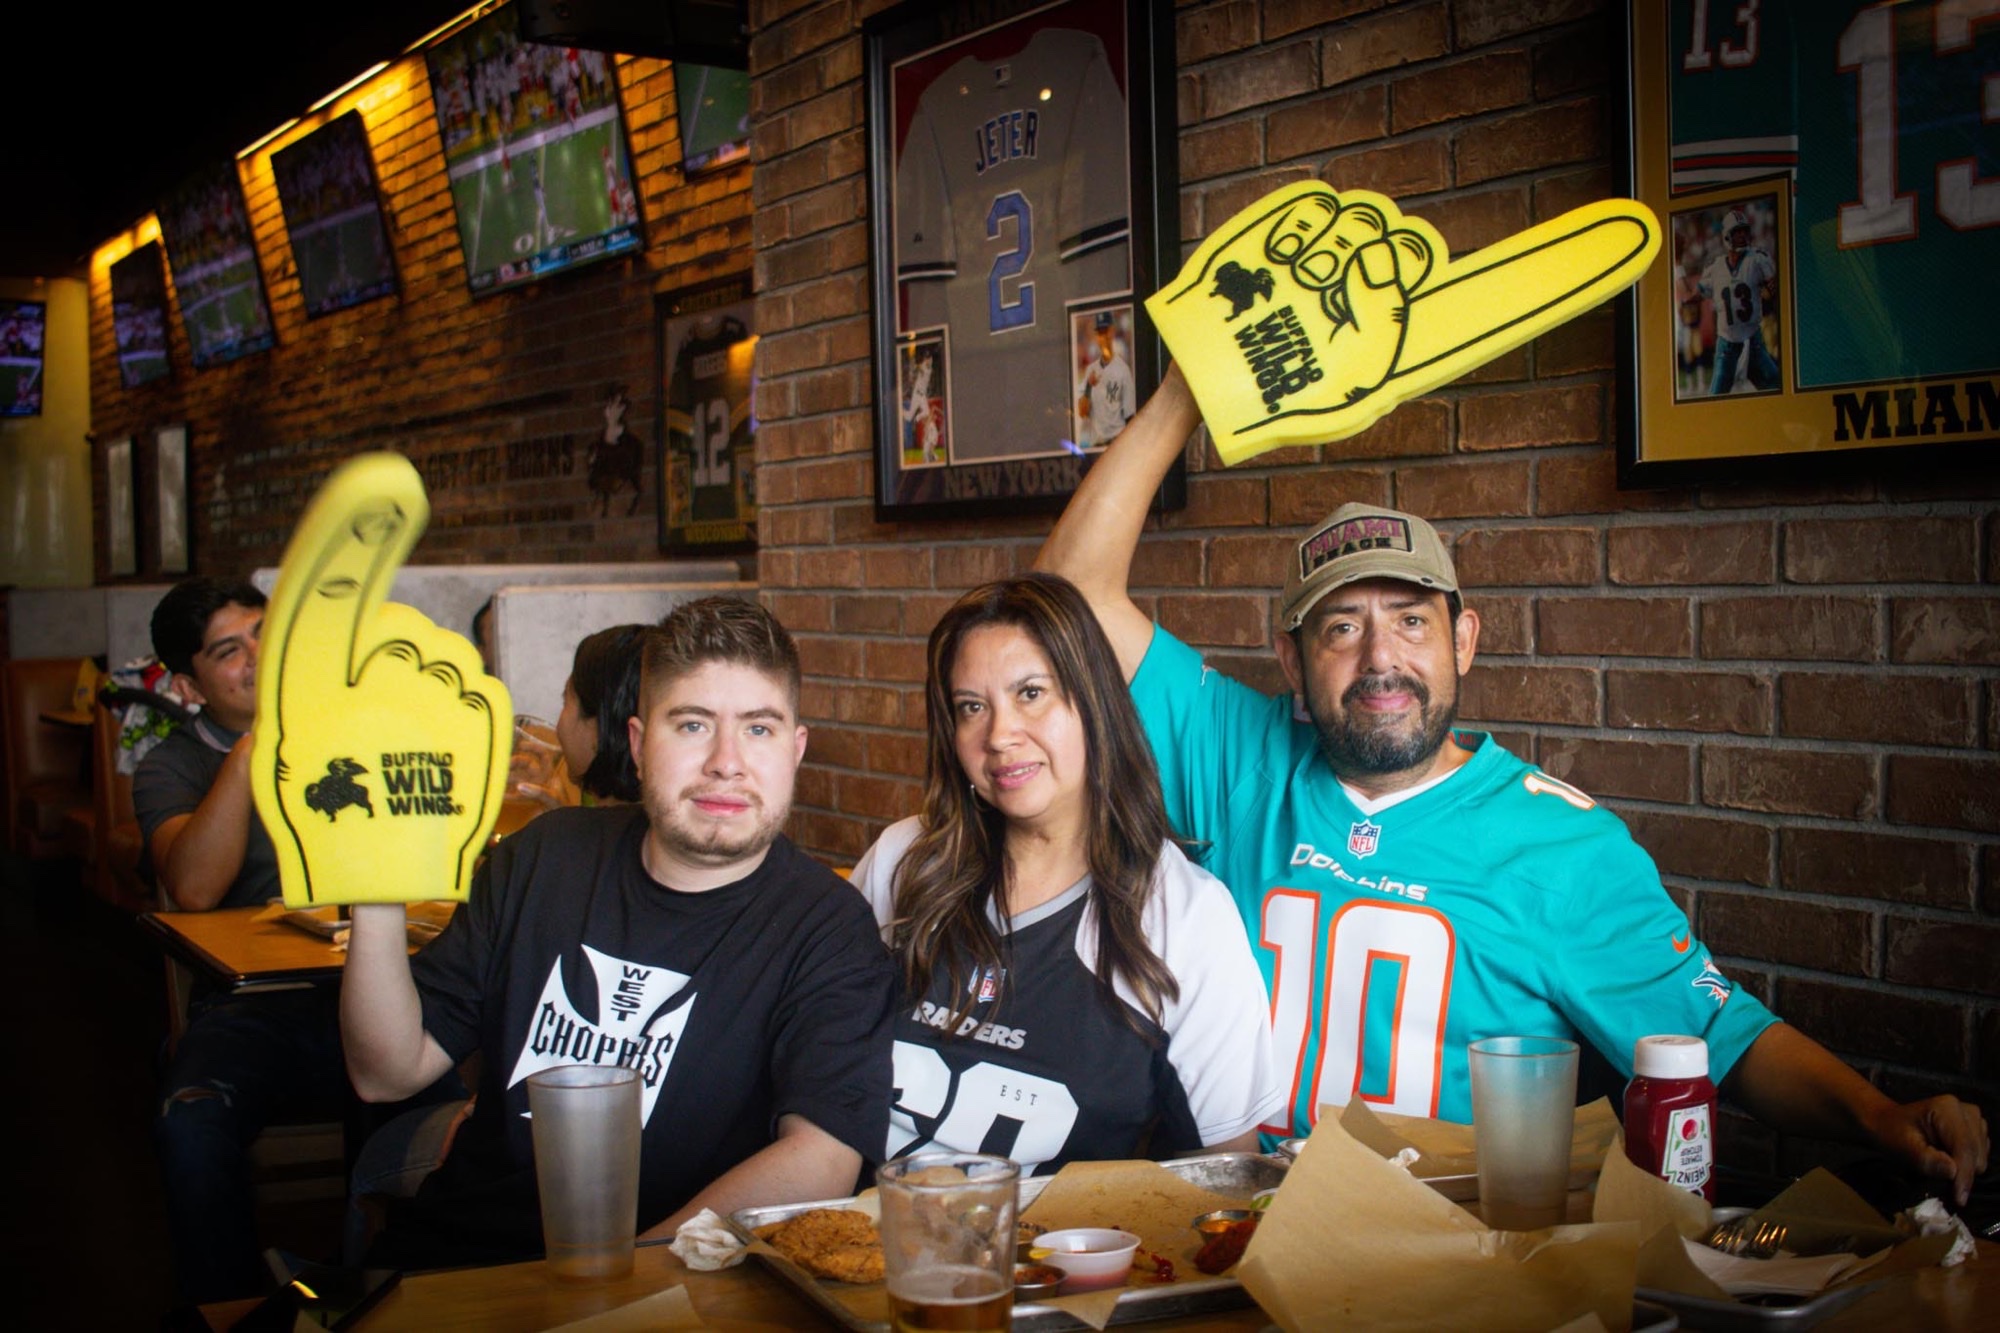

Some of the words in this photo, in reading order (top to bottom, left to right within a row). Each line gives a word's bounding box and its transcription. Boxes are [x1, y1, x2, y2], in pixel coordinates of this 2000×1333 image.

[975, 109, 1039, 176] JETER
[986, 189, 1036, 336] 2
[1721, 283, 1755, 326] 13
[1254, 311, 1310, 395] WILD
[1278, 305, 1324, 383] BUFFALO
[693, 398, 732, 487] 12
[945, 466, 999, 500] NEW
[1005, 457, 1083, 498] YORK
[1309, 518, 1402, 560] MIAMI
[381, 752, 453, 768] BUFFALO
[382, 768, 454, 795] WILD
[1351, 836, 1372, 852] NFL
[610, 965, 652, 1021] WEST
[1259, 886, 1456, 1136] 10
[1000, 1084, 1038, 1107] EST
[1677, 1166, 1705, 1184] HEINZ
